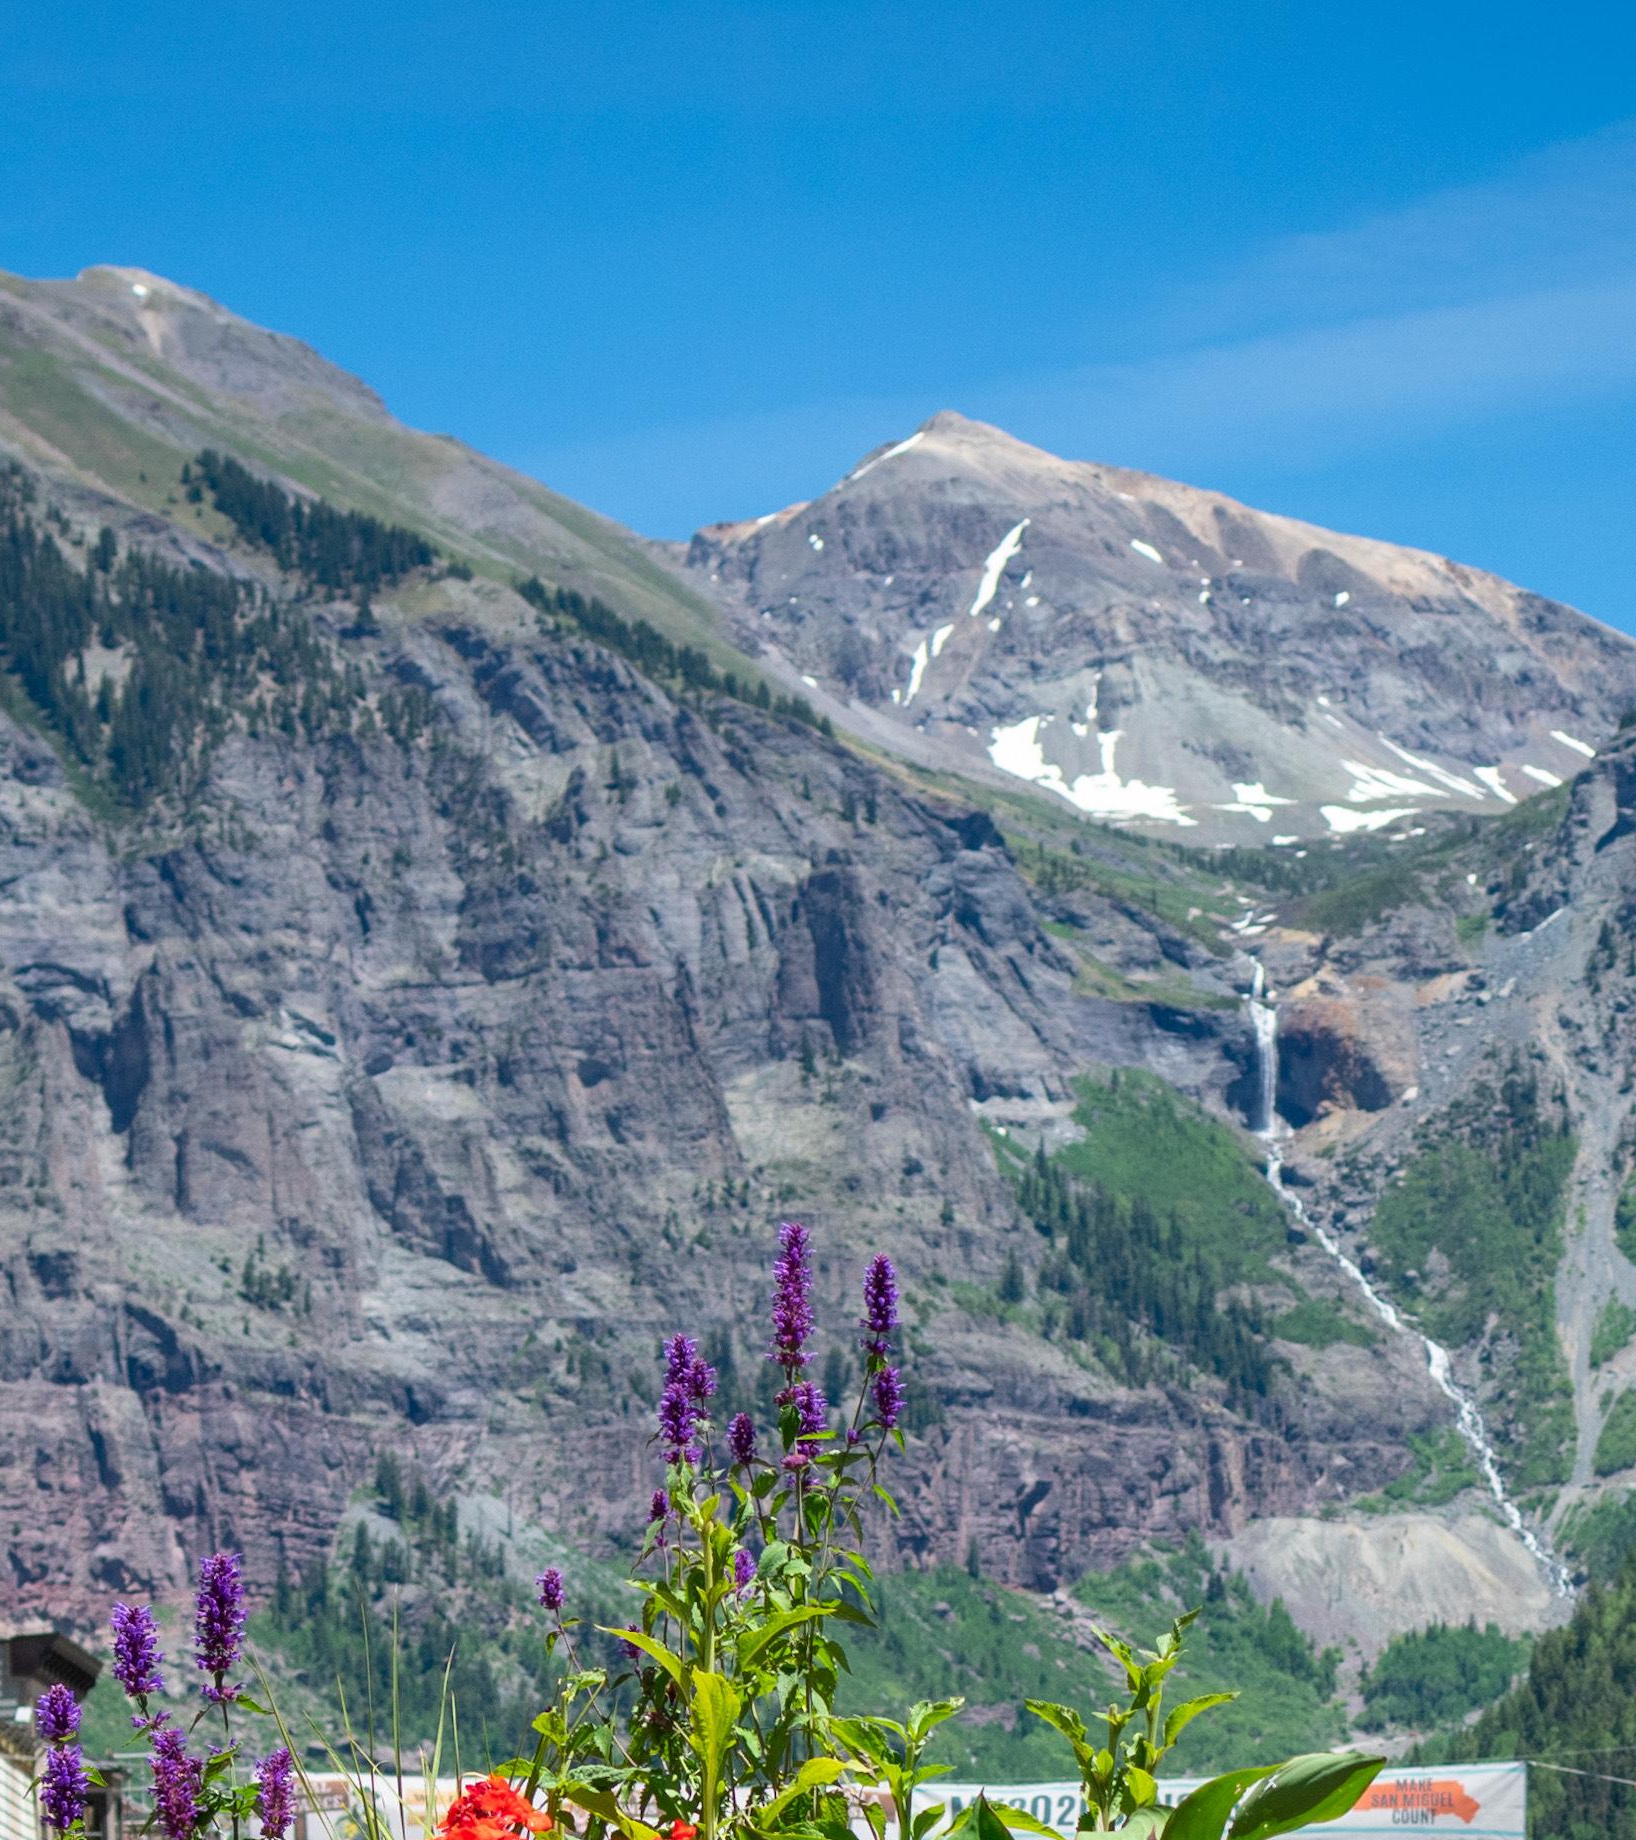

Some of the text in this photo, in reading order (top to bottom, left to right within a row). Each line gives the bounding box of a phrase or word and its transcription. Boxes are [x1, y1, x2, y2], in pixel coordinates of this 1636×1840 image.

[1396, 1778, 1433, 1792] MAKE
[1371, 1791, 1454, 1808] SAN MIGUEL
[1391, 1808, 1436, 1825] COUNT
